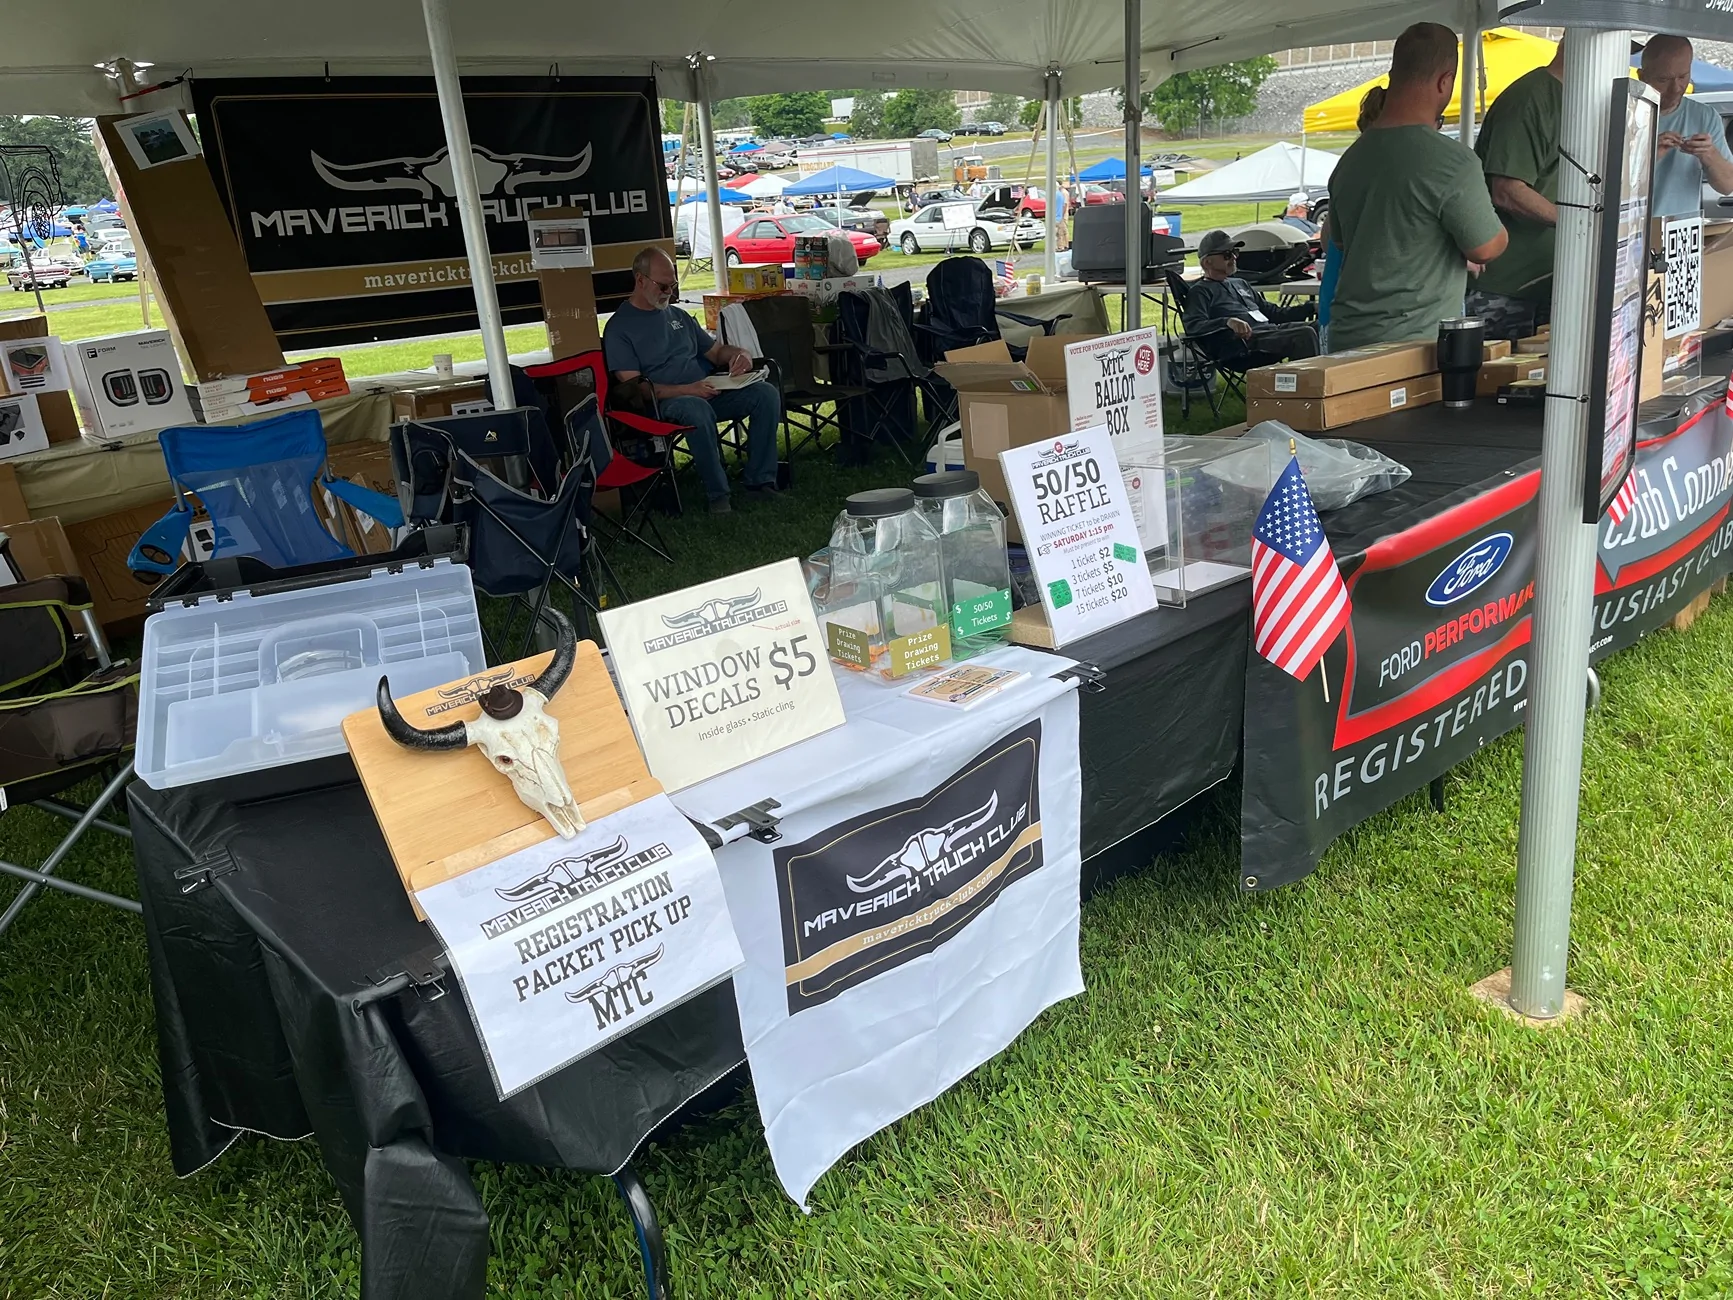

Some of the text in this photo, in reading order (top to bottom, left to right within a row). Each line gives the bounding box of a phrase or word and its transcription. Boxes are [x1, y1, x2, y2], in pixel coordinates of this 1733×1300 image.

[250, 204, 448, 238] MAVERICK
[570, 189, 648, 217] CLUB
[1070, 332, 1152, 355] VOTE FOR YOUR FAVORITE MTC TRUCKS
[1139, 349, 1151, 360] VOTE
[1101, 356, 1124, 377] MTC
[1137, 360, 1149, 371] HERE
[1095, 373, 1135, 409] BALLOT
[1106, 405, 1130, 436] BOX
[1031, 447, 1091, 469] MAVERICK TRUCK CLUB
[1032, 458, 1100, 500] 50/50
[1037, 484, 1111, 526] RAFFLE
[1040, 528, 1067, 541] WINNING
[1067, 520, 1085, 533] TICKET
[1092, 517, 1100, 525] be
[1100, 510, 1120, 521] DRAWN
[1053, 523, 1114, 548] SATURDAY 1:15 pm
[1071, 546, 1111, 569] 1 ticket $2
[1072, 560, 1114, 585] 3 tickets $5
[1444, 545, 1501, 595] Ford
[1075, 573, 1124, 599] 7 tickets $10
[1076, 586, 1128, 616] 15 tickets $20
[971, 612, 998, 627] Tickets
[973, 600, 993, 614] 50/50
[644, 601, 787, 653] MAVERICK TRUCK CLUB
[774, 618, 801, 631] actual size
[838, 627, 856, 640] Prize
[908, 631, 933, 647] Prize
[836, 638, 861, 654] Drawing
[837, 649, 862, 664] Tickets
[904, 642, 939, 659] Drawing
[643, 635, 817, 703] WINDOW $5
[905, 654, 940, 671] Tickets
[1314, 659, 1527, 820] REGISTERED
[1696, 520, 1733, 576] CLUB
[1378, 642, 1421, 689] FORD
[427, 675, 535, 716] MAVERICK CLUB
[665, 677, 761, 729] DECALS
[699, 700, 796, 741] Inside glass Static cling
[804, 801, 1027, 937] MAVERICK TRUCK CLUB
[481, 843, 671, 938] MAVERICK TRUCK CLUB
[514, 870, 674, 965] REGISTRATION
[862, 869, 994, 945] mavericktruckclub.com
[513, 895, 692, 1002] PACKET PICK UP
[588, 970, 654, 1031] MTC
